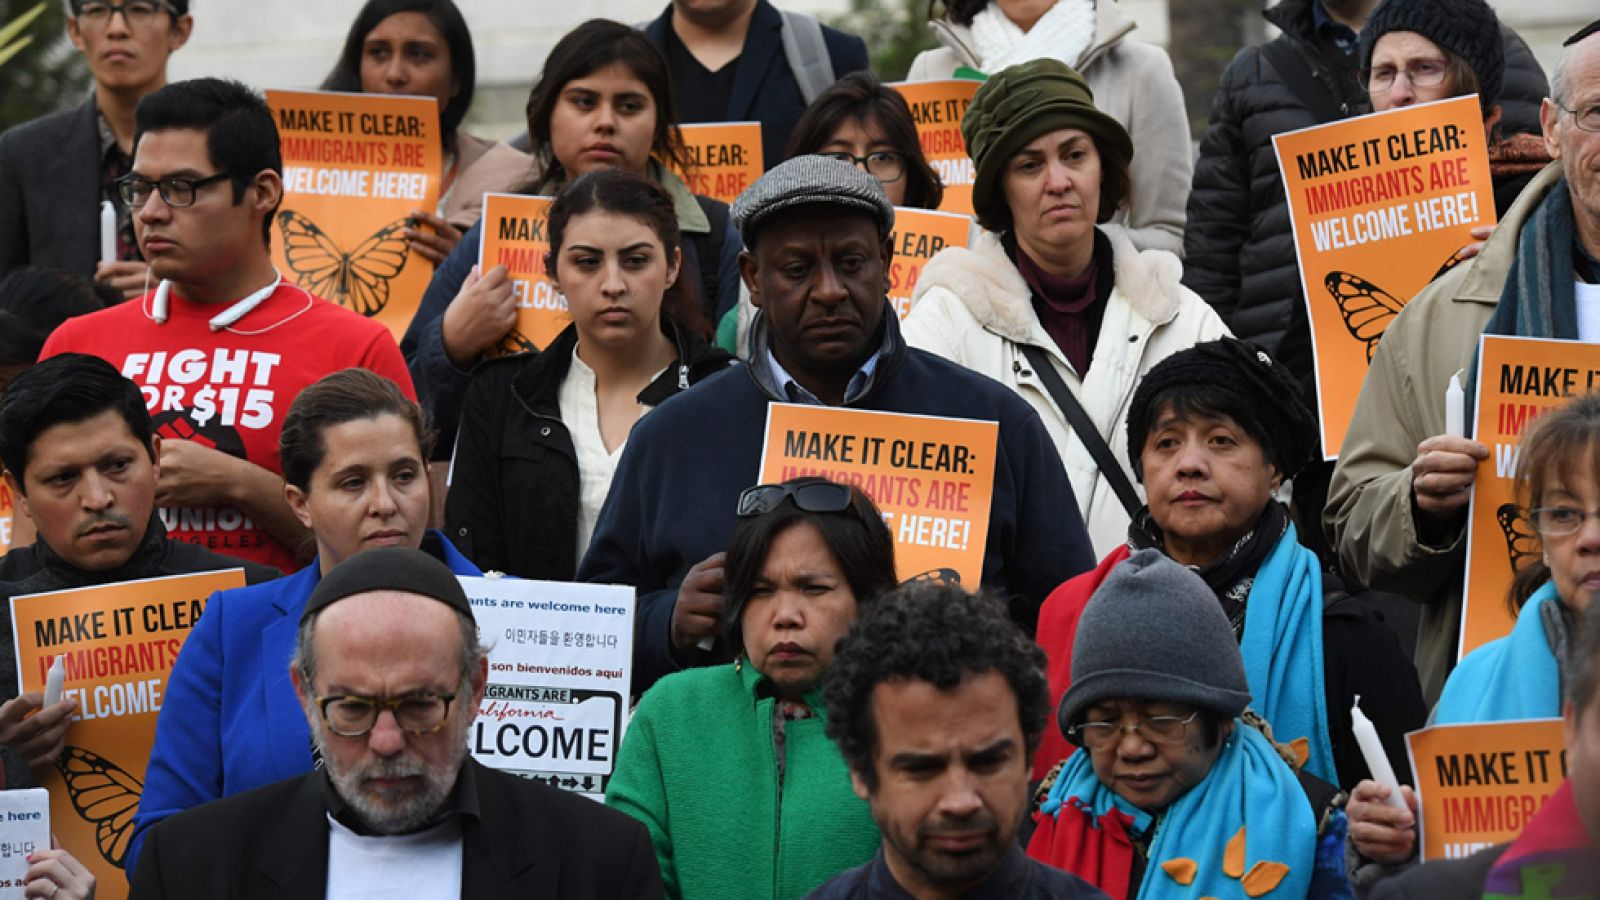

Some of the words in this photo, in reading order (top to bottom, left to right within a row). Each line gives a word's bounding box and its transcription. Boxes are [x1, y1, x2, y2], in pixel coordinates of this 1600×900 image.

[280, 108, 333, 133] MAKE
[338, 112, 355, 134] IT
[360, 113, 426, 138] CLEAR:
[911, 100, 942, 124] AKE
[945, 98, 964, 121] IT
[281, 136, 388, 167] IMMIGRANTS
[392, 143, 425, 168] ARE
[1296, 143, 1360, 181] MAKE
[1362, 138, 1381, 167] IT
[1387, 124, 1468, 162] CLEAR:
[371, 171, 429, 201] HERE!
[1304, 165, 1425, 215] IMMIGRANTS
[1429, 156, 1470, 191] ARE
[499, 217, 548, 242] MAK
[1310, 204, 1414, 253] WELCOME
[1413, 191, 1480, 233] HERE!
[892, 231, 950, 259] LEAR
[512, 279, 569, 312] ELCO
[121, 347, 282, 387] FIGHT
[1499, 363, 1579, 398] MAKE
[140, 385, 186, 411] OR
[190, 384, 275, 430] $15
[784, 430, 856, 463] MAKE
[861, 437, 886, 466] IT
[890, 439, 977, 475] CLEAR:
[925, 479, 972, 513] ARE
[898, 513, 971, 551] HERE!
[35, 610, 107, 648] MAKE
[112, 607, 135, 637] IT
[142, 598, 209, 633] CLEA
[500, 599, 525, 609] are
[528, 600, 591, 613] welcome
[594, 603, 626, 615] here
[505, 628, 560, 646] 이민자들을
[563, 631, 618, 649] 환영합니다
[491, 663, 513, 672] son
[517, 663, 592, 677] bienvenidos
[484, 686, 540, 702] IGRANTS
[541, 688, 568, 702] ARE
[478, 700, 565, 722] alifornia
[475, 721, 610, 762] LCOME
[1435, 752, 1520, 787] MAKE
[1525, 750, 1551, 784] IT
[8, 811, 41, 821] here
[1, 841, 36, 858] 합니다
